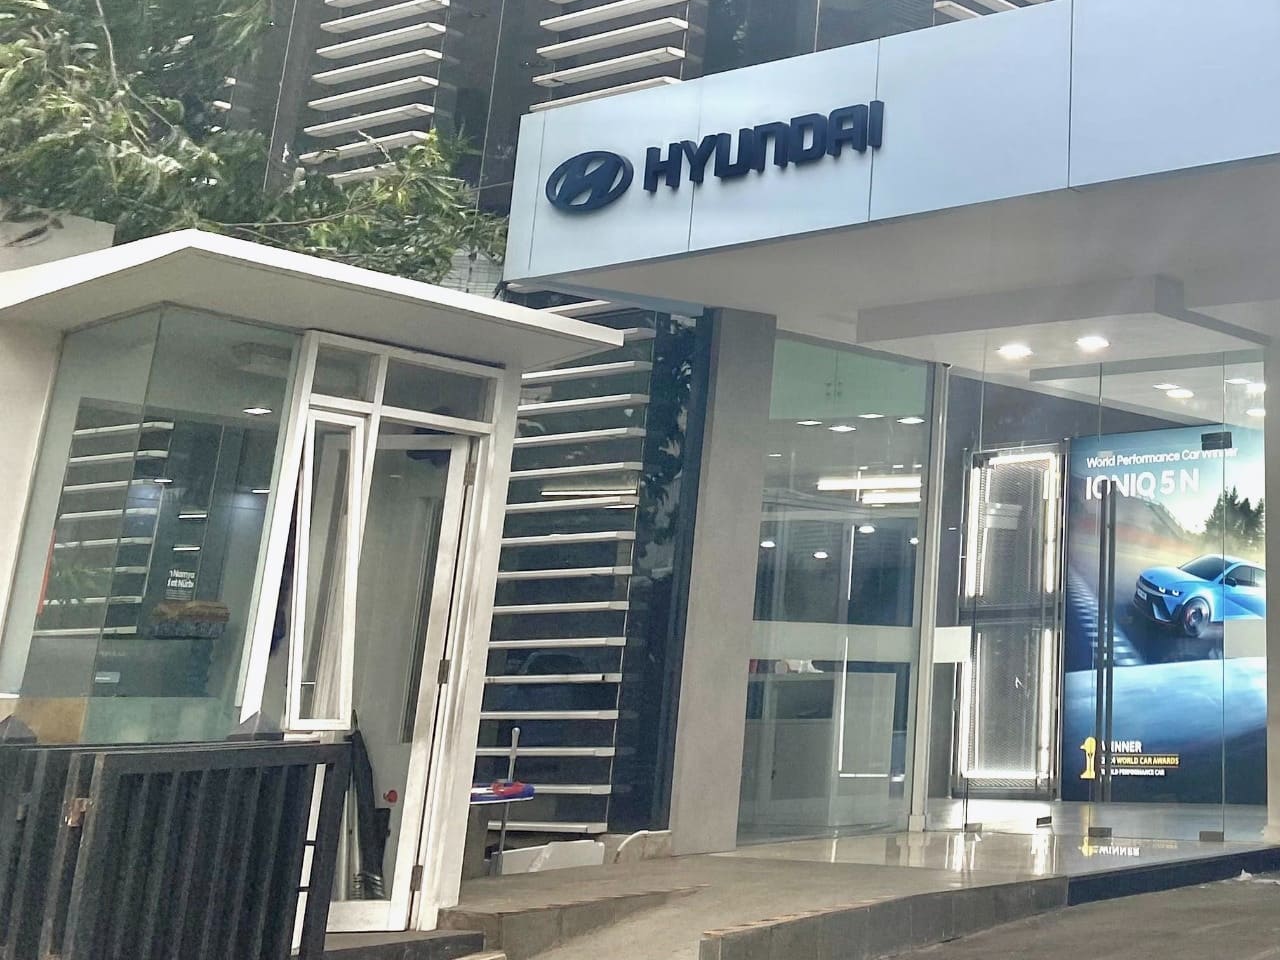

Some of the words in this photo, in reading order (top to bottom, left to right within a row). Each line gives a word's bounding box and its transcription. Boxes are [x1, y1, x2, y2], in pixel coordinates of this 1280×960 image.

[643, 100, 885, 193] HYUNDAI
[1087, 454, 1116, 469] World
[1117, 451, 1180, 466] Performance
[1181, 449, 1200, 460] Car
[1085, 472, 1157, 500] IONIQ
[1160, 470, 1175, 495] 5
[1180, 468, 1200, 494] N
[1116, 756, 1139, 765] WORLD
[1139, 756, 1152, 765] CAR
[1152, 756, 1180, 765] AWARDS
